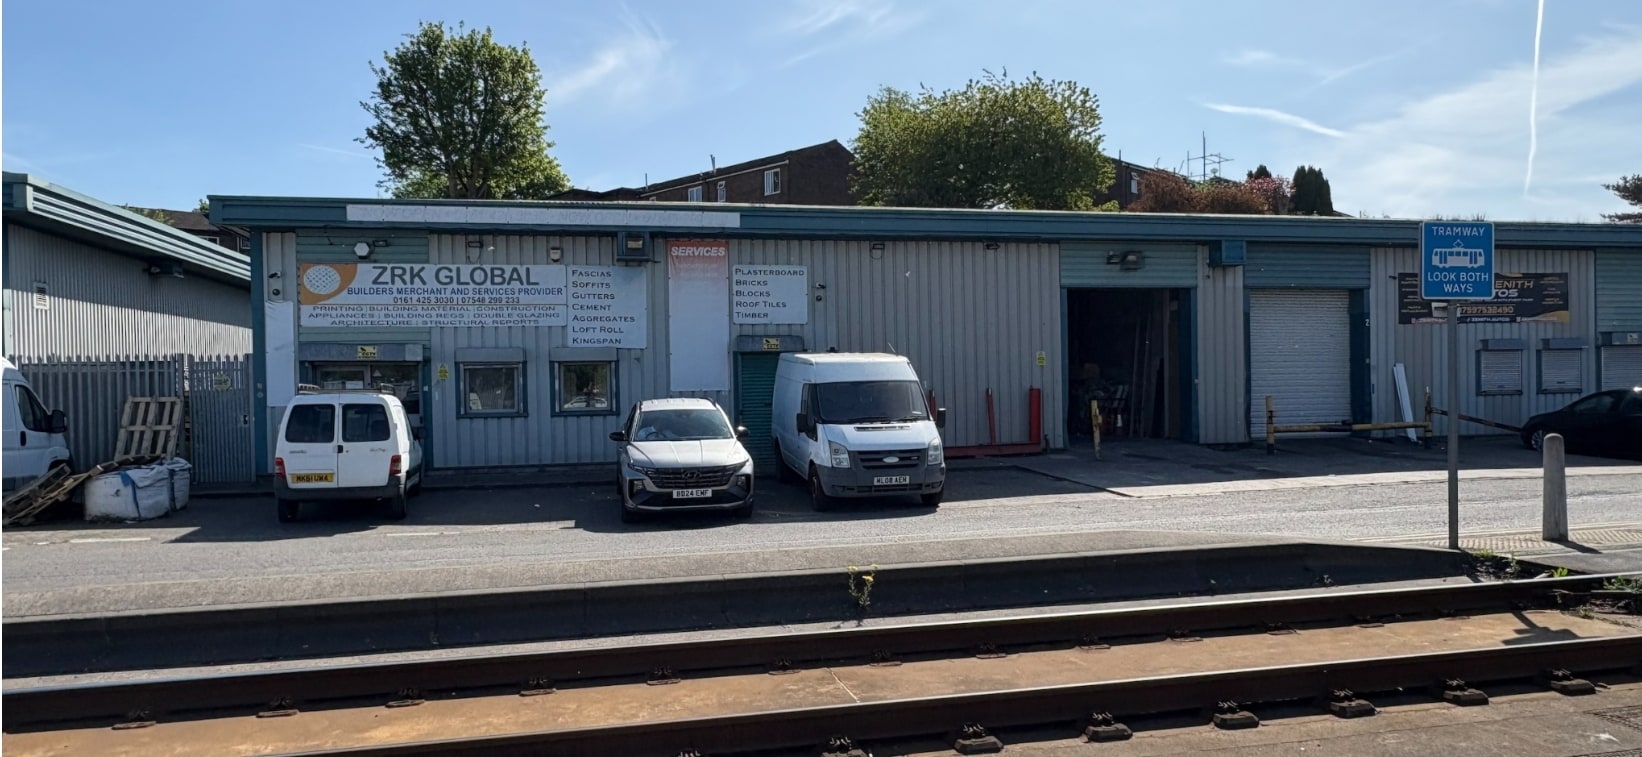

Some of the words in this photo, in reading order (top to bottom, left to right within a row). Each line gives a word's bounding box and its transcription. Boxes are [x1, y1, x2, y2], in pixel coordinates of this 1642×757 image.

[1431, 226, 1485, 236] TRAMWAY
[671, 246, 726, 257] SERVICES
[371, 265, 428, 286] ZRK
[434, 266, 540, 286] GLOBAL
[735, 268, 805, 276] PLASTERBOARD
[1427, 271, 1456, 281] LOOK
[1460, 272, 1489, 281] BOTH
[1443, 283, 1473, 293] WAYS
[1495, 280, 1534, 288] ENITH
[347, 287, 394, 295] BUILDERS
[396, 287, 448, 295] MERCHANT
[450, 287, 470, 295] AND
[471, 287, 516, 296] SERVICES
[517, 287, 563, 296] PROVIDER
[571, 292, 615, 300] GUTTERS
[571, 303, 612, 311] CEMENT
[571, 314, 636, 322] AGGREGATES
